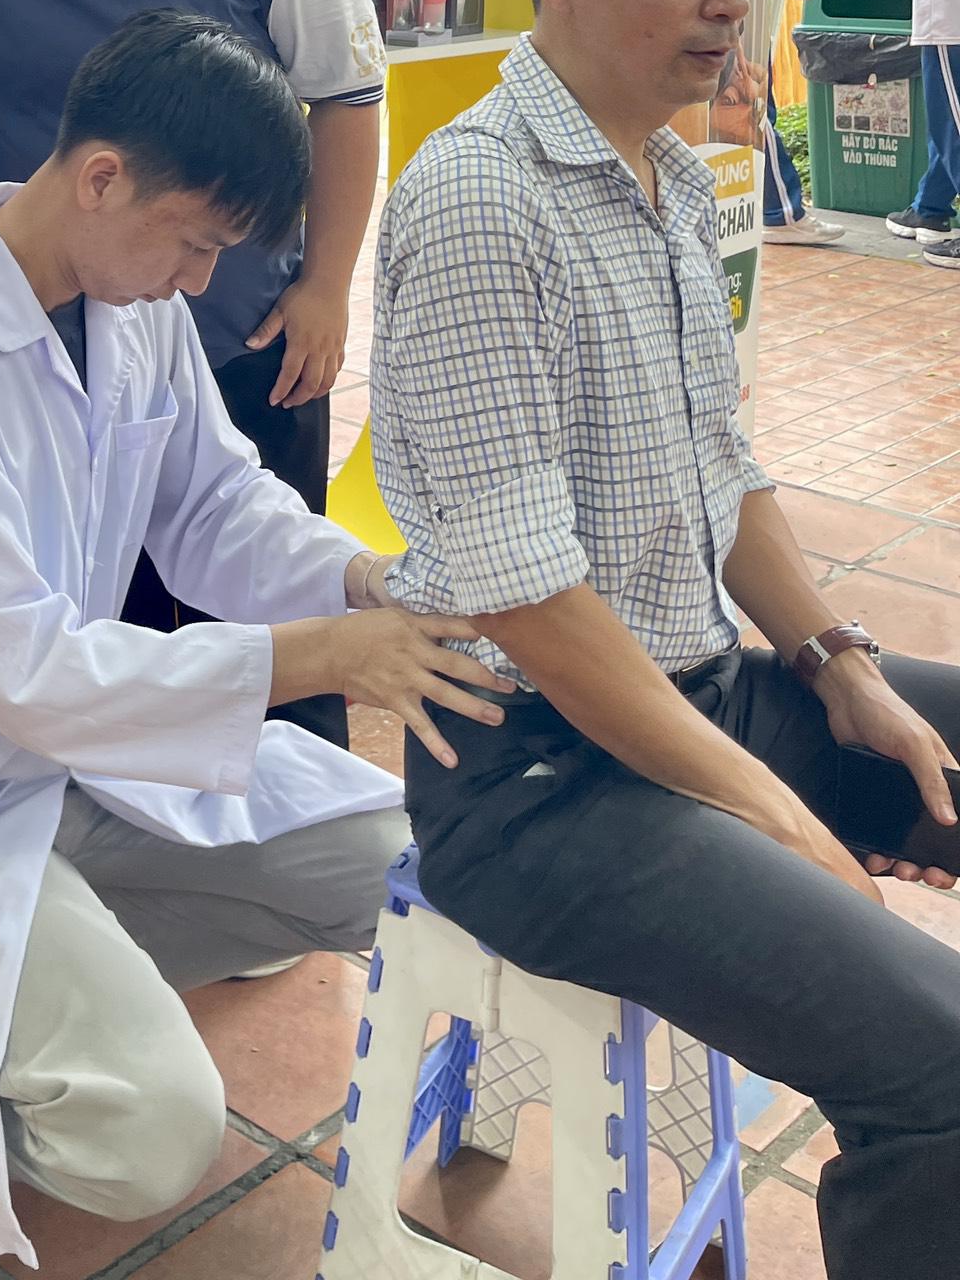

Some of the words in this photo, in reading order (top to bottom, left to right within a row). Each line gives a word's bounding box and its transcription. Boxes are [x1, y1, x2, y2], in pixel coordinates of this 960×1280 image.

[841, 132, 861, 149] HÃY
[878, 136, 898, 152] RÁC
[842, 149, 863, 165] VÀO
[718, 197, 755, 241] CHÂN
